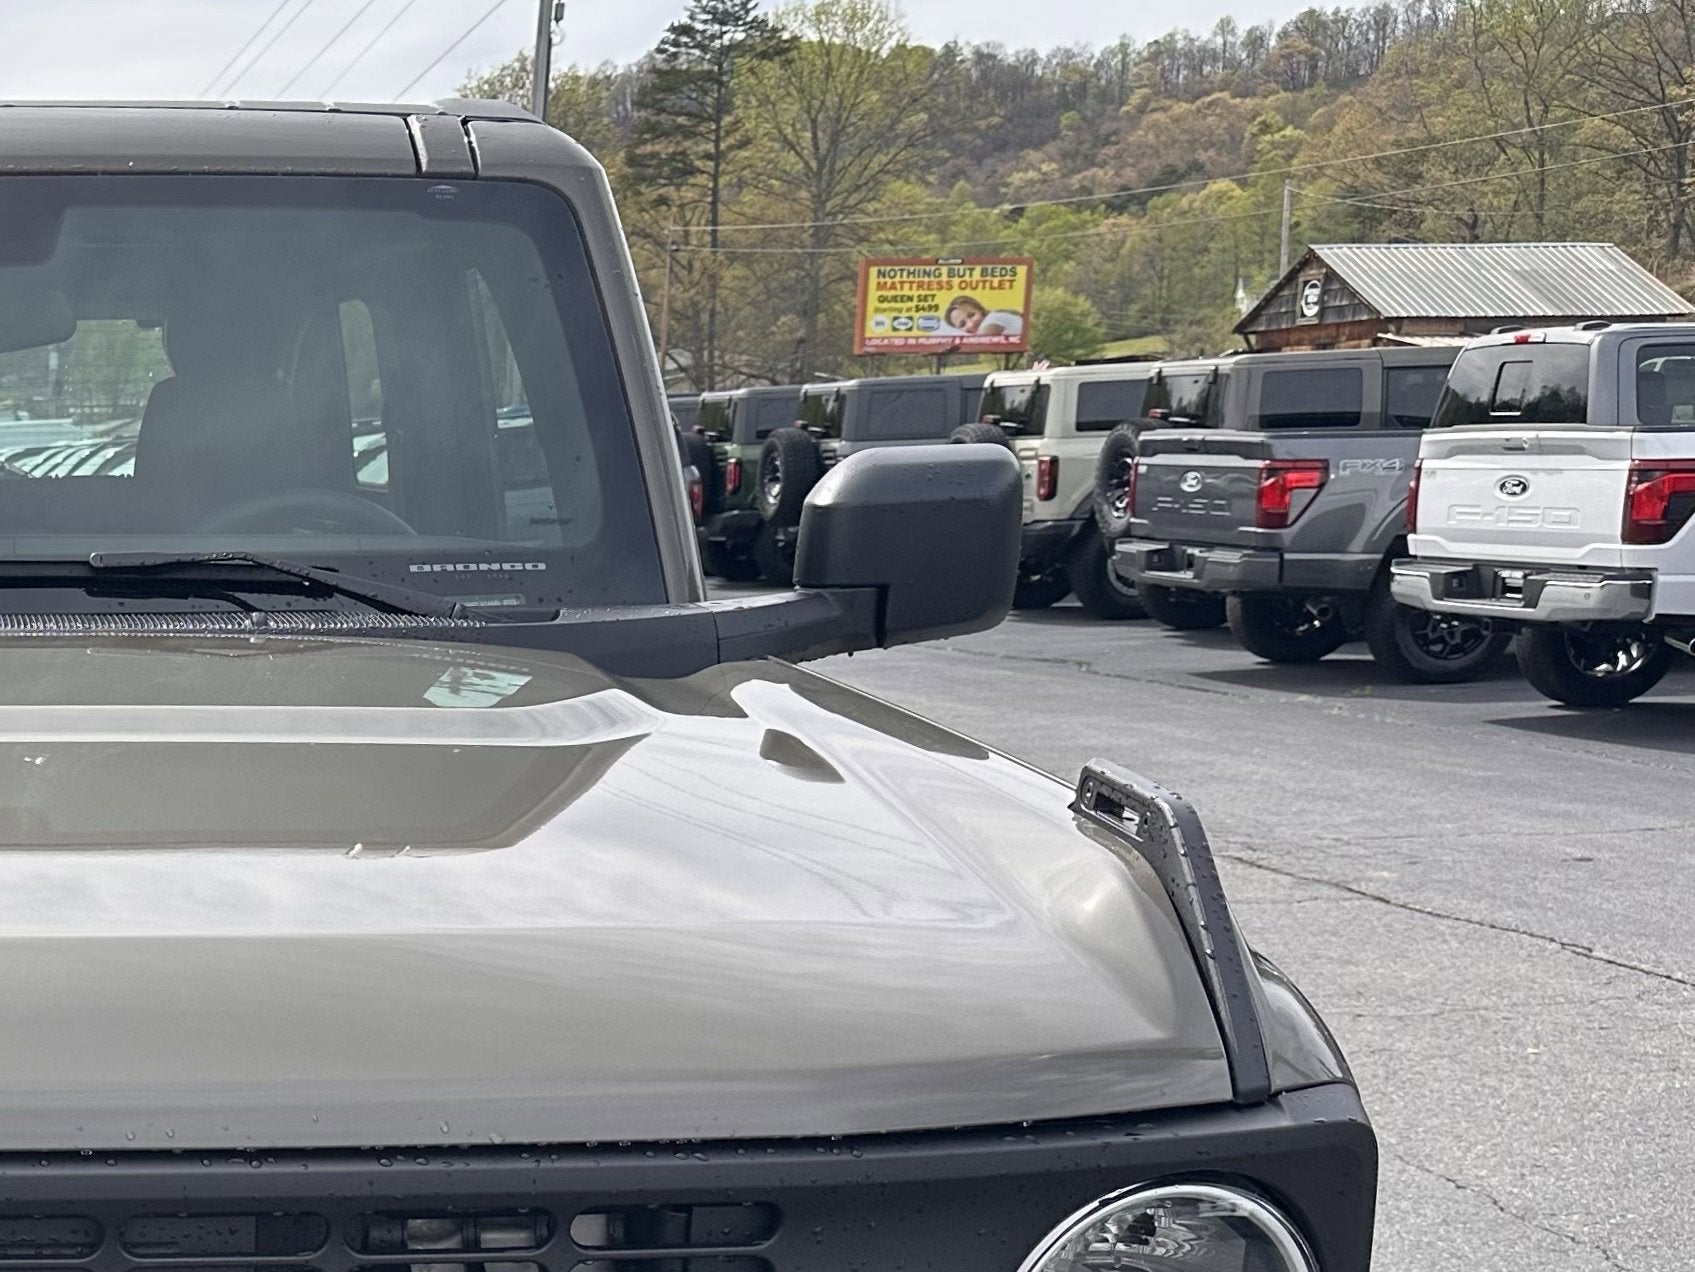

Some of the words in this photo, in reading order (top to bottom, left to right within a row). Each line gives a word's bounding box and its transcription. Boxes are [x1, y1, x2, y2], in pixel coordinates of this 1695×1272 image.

[876, 267, 942, 279] NOTHING
[947, 267, 975, 279] BUT
[980, 266, 1018, 278] BEDS
[876, 280, 953, 292] MATTRESS
[958, 279, 1016, 290] OUTLET
[877, 294, 914, 304] QUEEN
[916, 294, 936, 303] SET
[915, 304, 940, 313] $499
[1339, 458, 1403, 476] FX4
[1447, 504, 1581, 530] F-150
[409, 562, 547, 573] BRONCO
